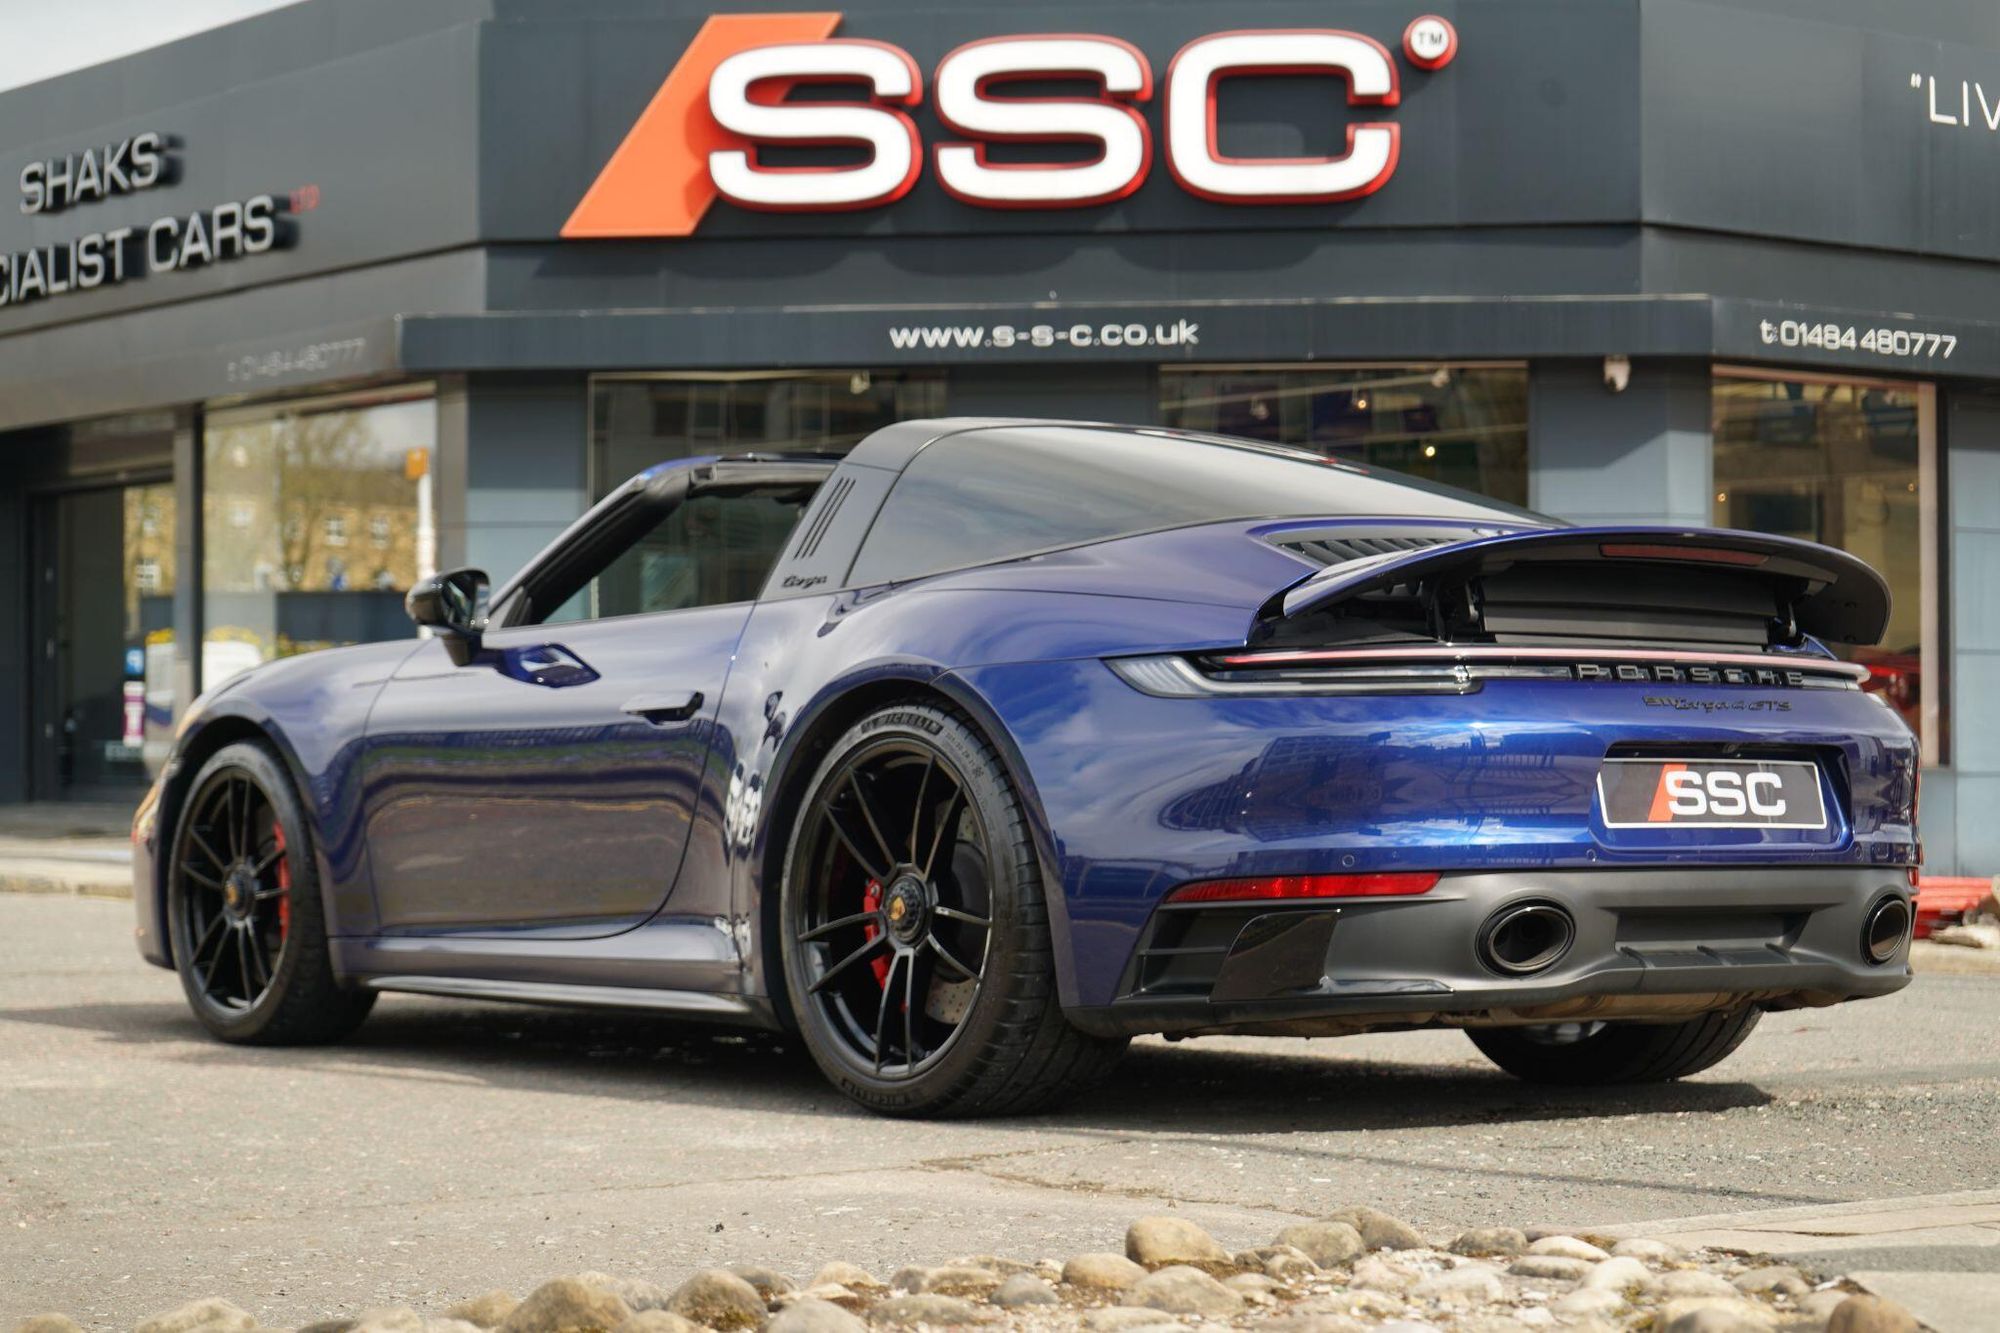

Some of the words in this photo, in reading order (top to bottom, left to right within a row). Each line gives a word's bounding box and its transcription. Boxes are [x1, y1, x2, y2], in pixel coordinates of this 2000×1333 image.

[1418, 31, 1443, 46] TM
[706, 30, 1400, 208] SSC
[20, 131, 160, 214] SHAKS
[149, 194, 274, 272] CARS
[889, 318, 1199, 348] www.s-s-c.co.uk
[1575, 663, 1803, 687] PORSCHE
[1664, 770, 1787, 817] SSC
